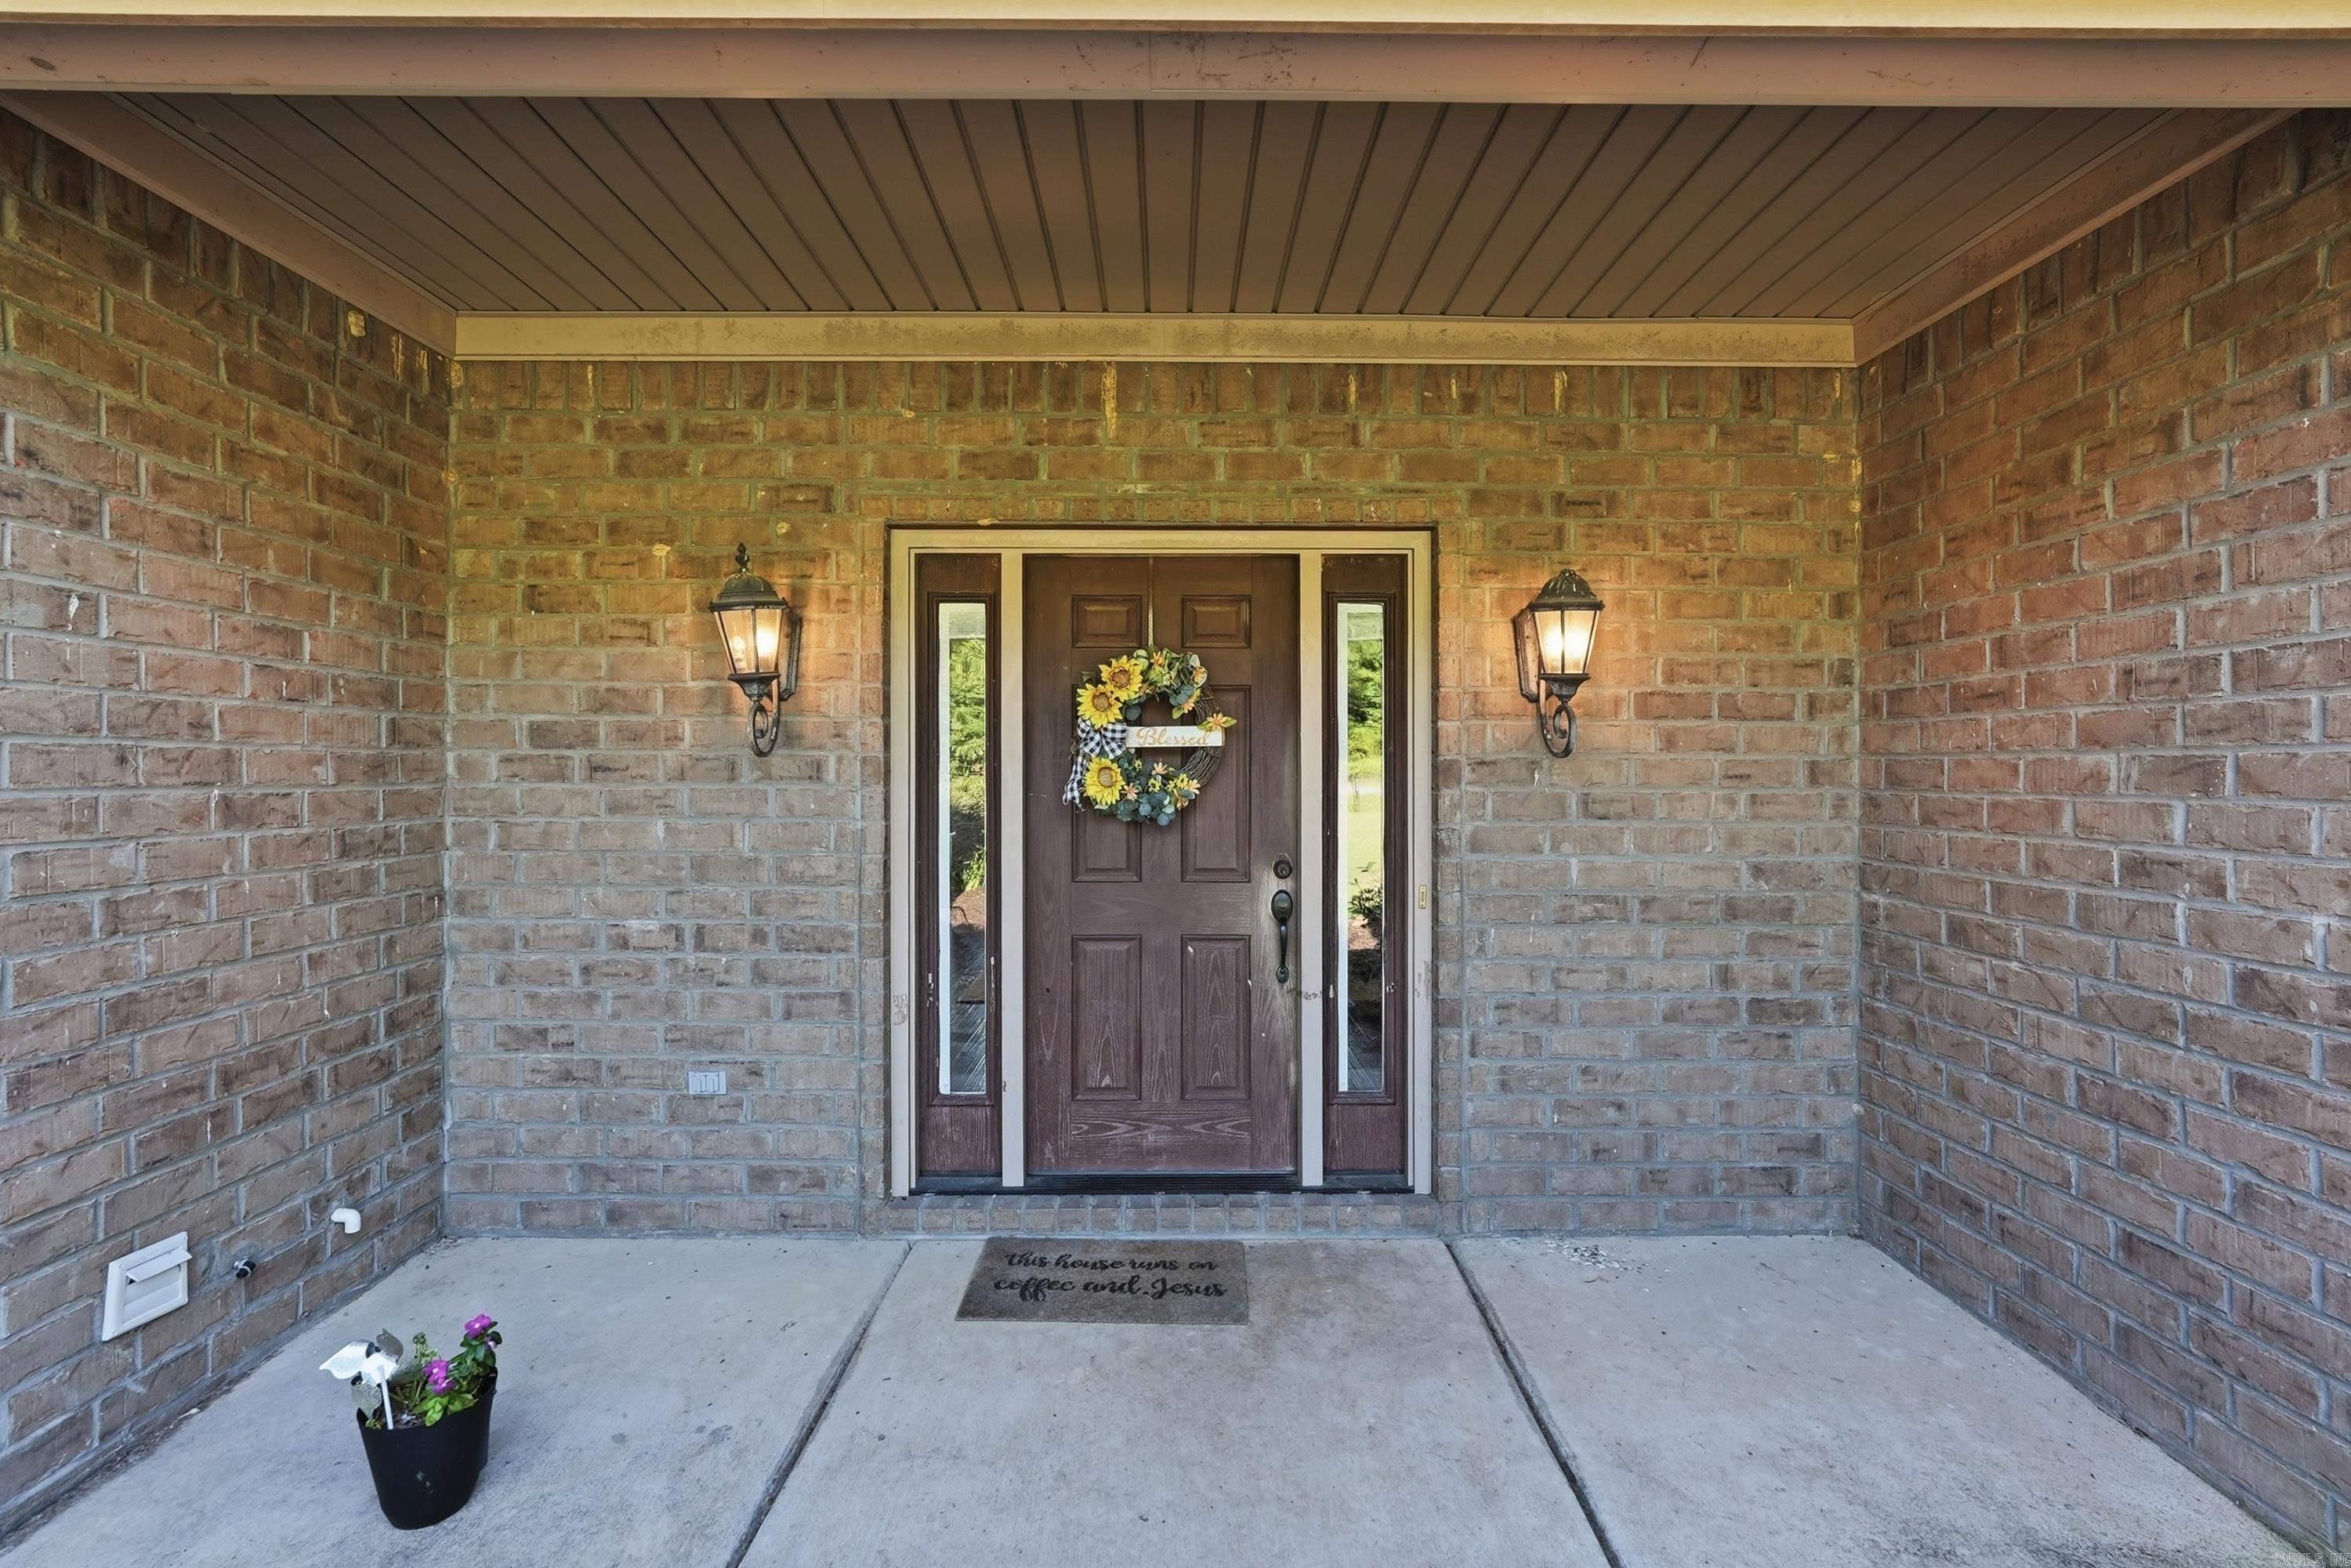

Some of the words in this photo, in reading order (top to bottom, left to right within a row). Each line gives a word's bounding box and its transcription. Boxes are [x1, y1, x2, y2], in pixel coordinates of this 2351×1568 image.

[1136, 727, 1212, 746] Blessed
[1004, 1251, 1049, 1268] this
[1054, 1253, 1125, 1270] house
[1128, 1258, 1179, 1270] runs
[1189, 1260, 1217, 1270] on
[994, 1276, 1075, 1302] coffee
[1083, 1275, 1142, 1295] and
[1143, 1276, 1227, 1300] Jesus
